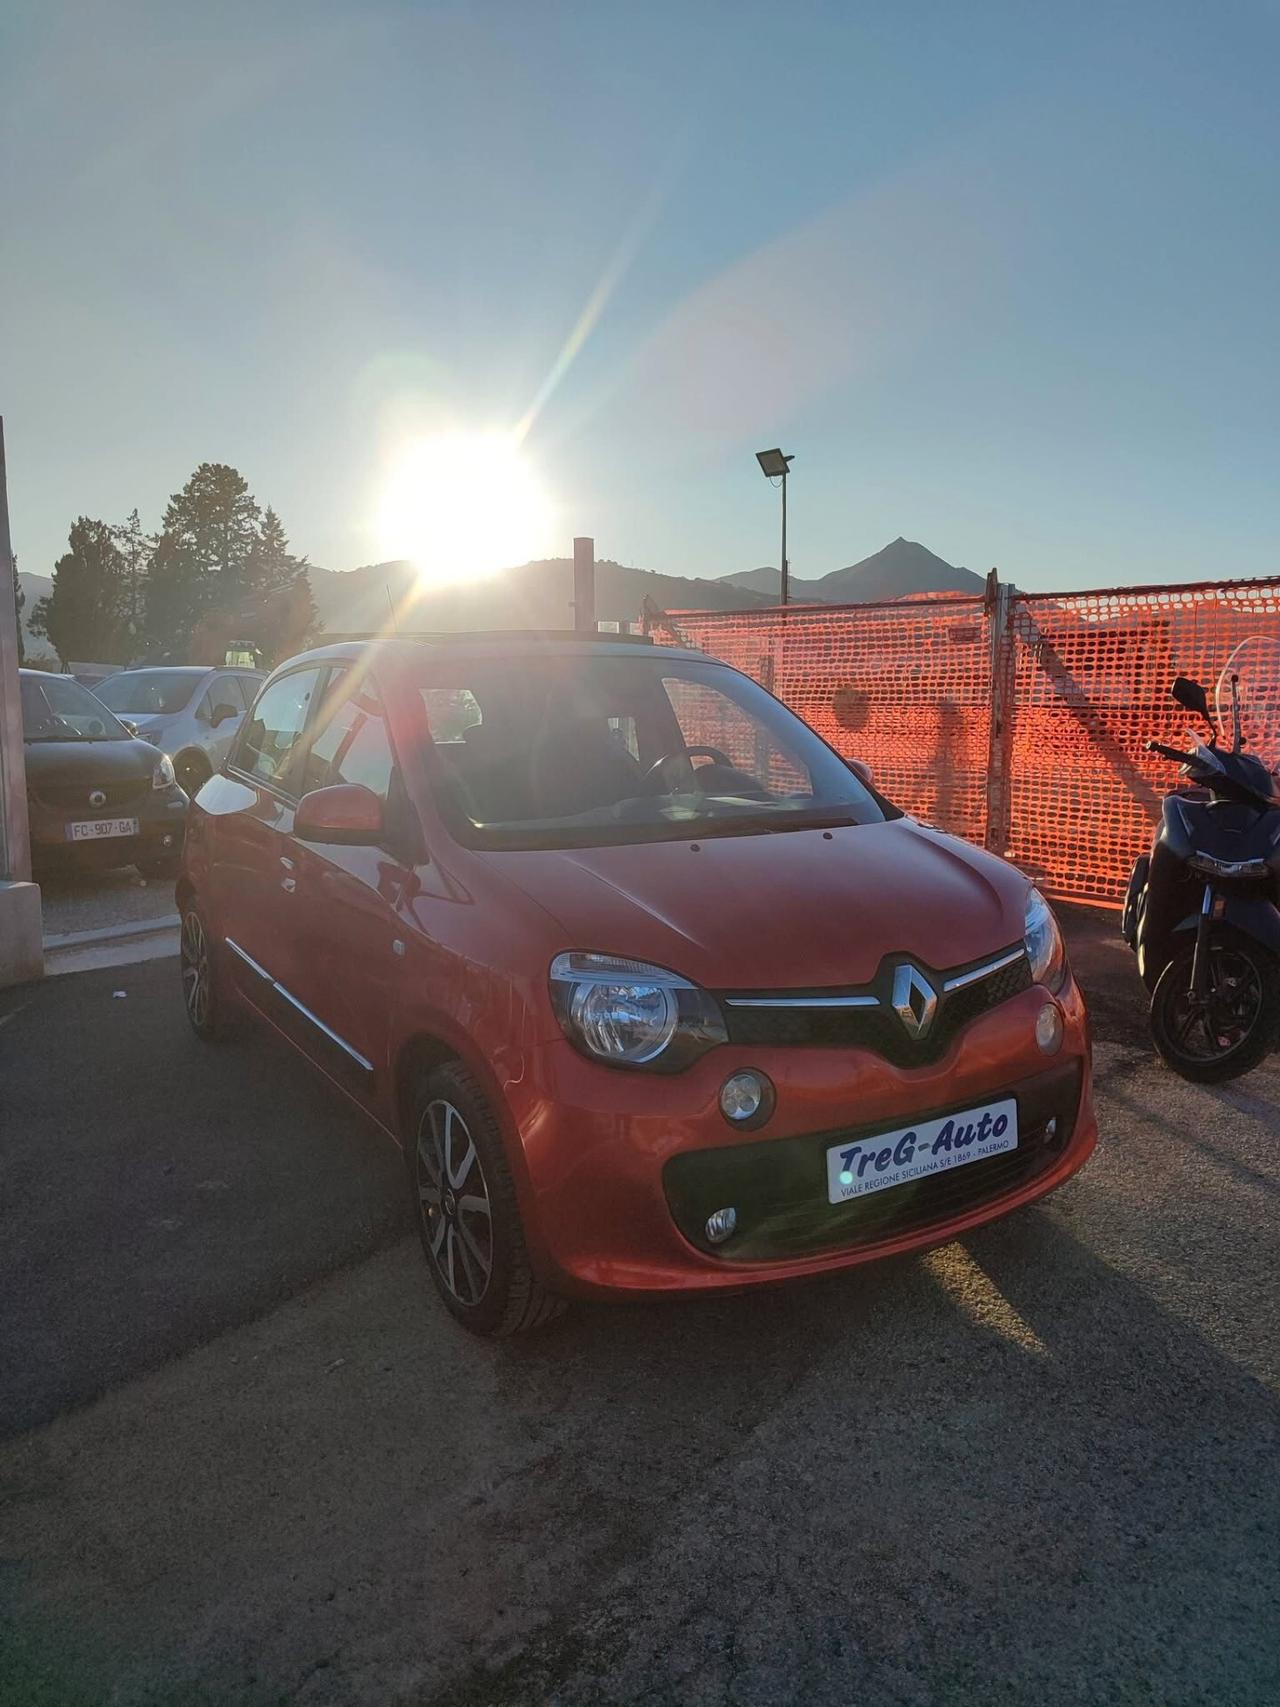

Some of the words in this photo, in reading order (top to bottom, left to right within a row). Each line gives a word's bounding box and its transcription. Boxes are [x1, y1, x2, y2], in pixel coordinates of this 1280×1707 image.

[840, 1113, 1008, 1177] TreG-Auto
[841, 1184, 862, 1197] VIALE
[865, 1173, 900, 1191] REGIONE
[902, 1162, 939, 1179] SICILIANA
[953, 1152, 971, 1166] 1869
[978, 1140, 1010, 1156] PALERMO
